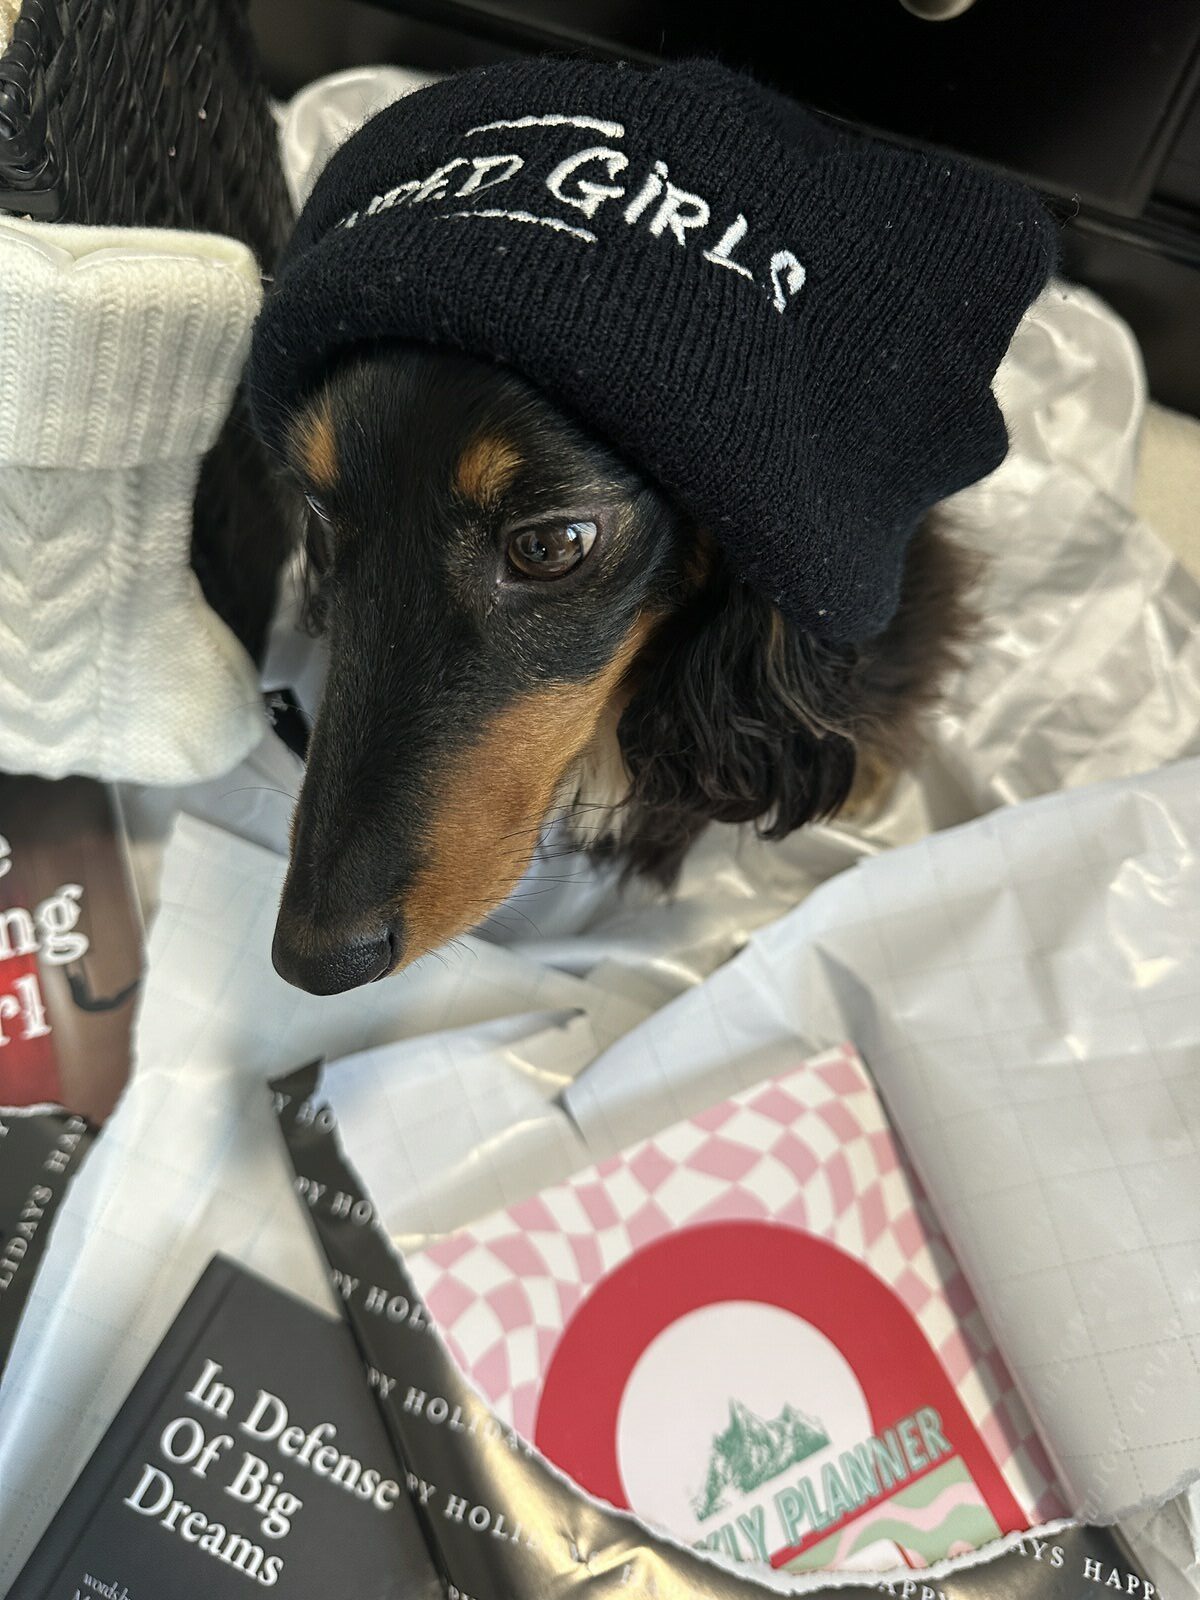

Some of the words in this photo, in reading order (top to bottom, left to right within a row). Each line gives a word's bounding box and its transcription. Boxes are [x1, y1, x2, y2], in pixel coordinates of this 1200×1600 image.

[160, 1416, 235, 1479] Of
[224, 1451, 303, 1539] Big
[184, 1358, 235, 1419] In
[238, 1389, 400, 1511] Defense
[773, 1405, 954, 1548] PLANNER
[123, 1463, 285, 1587] Dreams
